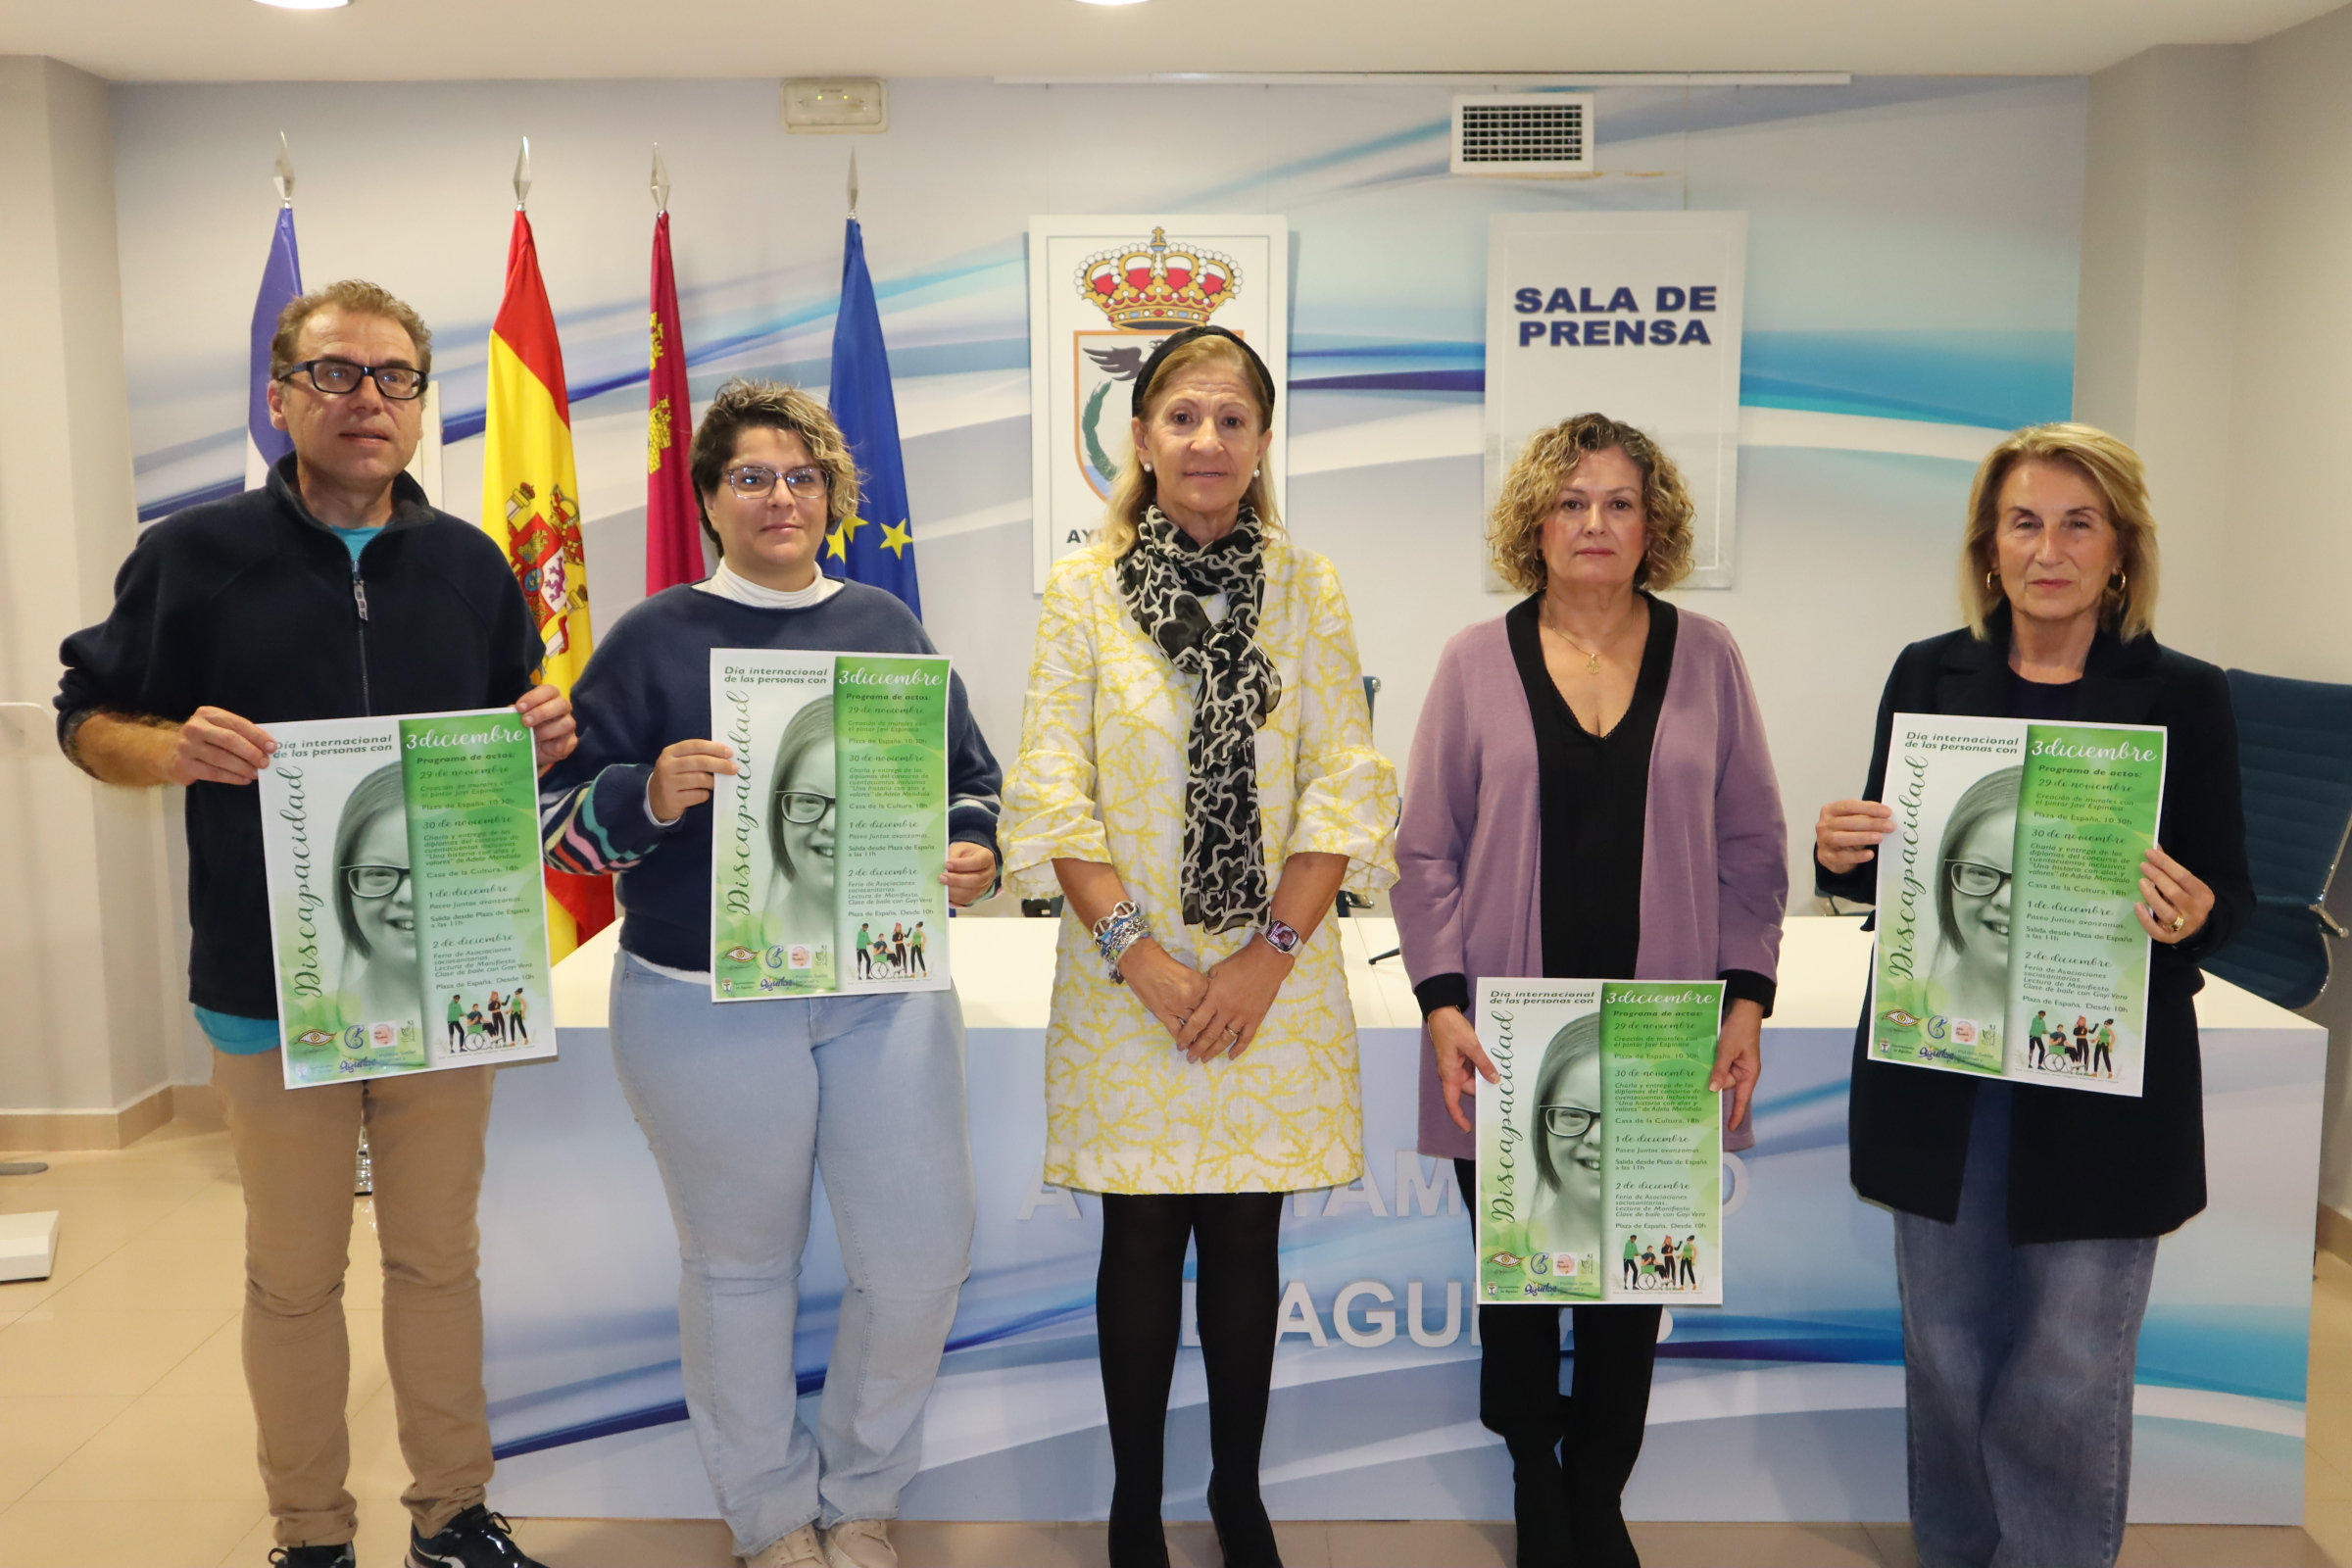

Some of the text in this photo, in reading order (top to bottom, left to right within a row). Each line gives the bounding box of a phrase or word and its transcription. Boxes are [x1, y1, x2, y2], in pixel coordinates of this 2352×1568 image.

[1514, 285, 1717, 314] SALA DE
[1519, 318, 1712, 347] PRENSA
[749, 666, 826, 675] internacional
[757, 676, 804, 685] personas
[301, 734, 391, 748] internacional
[1906, 731, 2018, 745] Día internacional
[312, 746, 366, 758] personas
[1939, 743, 1991, 754] personas
[416, 754, 466, 765] Programa
[875, 753, 921, 761] noviembre
[434, 768, 446, 777] de
[451, 764, 508, 776] noviembre
[2037, 764, 2089, 775] Programa
[2054, 778, 2066, 787] de
[2071, 779, 2132, 792] noviembre
[725, 690, 759, 915] Discapacidad
[437, 818, 451, 827] de
[454, 813, 510, 826] noviembre
[869, 819, 918, 828] diciembre
[2046, 829, 2060, 838] de
[2064, 830, 2124, 844] noviembre
[869, 866, 918, 875] diciembre
[1887, 755, 1929, 980] Discapacidad
[276, 765, 324, 998] Discapacidad
[434, 888, 449, 898] de
[452, 883, 510, 896] diciembre
[506, 906, 529, 915] España
[2034, 900, 2048, 909] de
[2051, 902, 2113, 915] diciembre
[440, 937, 455, 947] de
[457, 931, 514, 946] diciembre
[2106, 934, 2132, 943] España
[2033, 951, 2047, 960] de
[2050, 953, 2111, 967] diciembre
[2085, 1003, 2111, 1011] Desde
[1491, 1009, 1523, 1222] Discapacidad
[1637, 1134, 1689, 1143] diciembre
